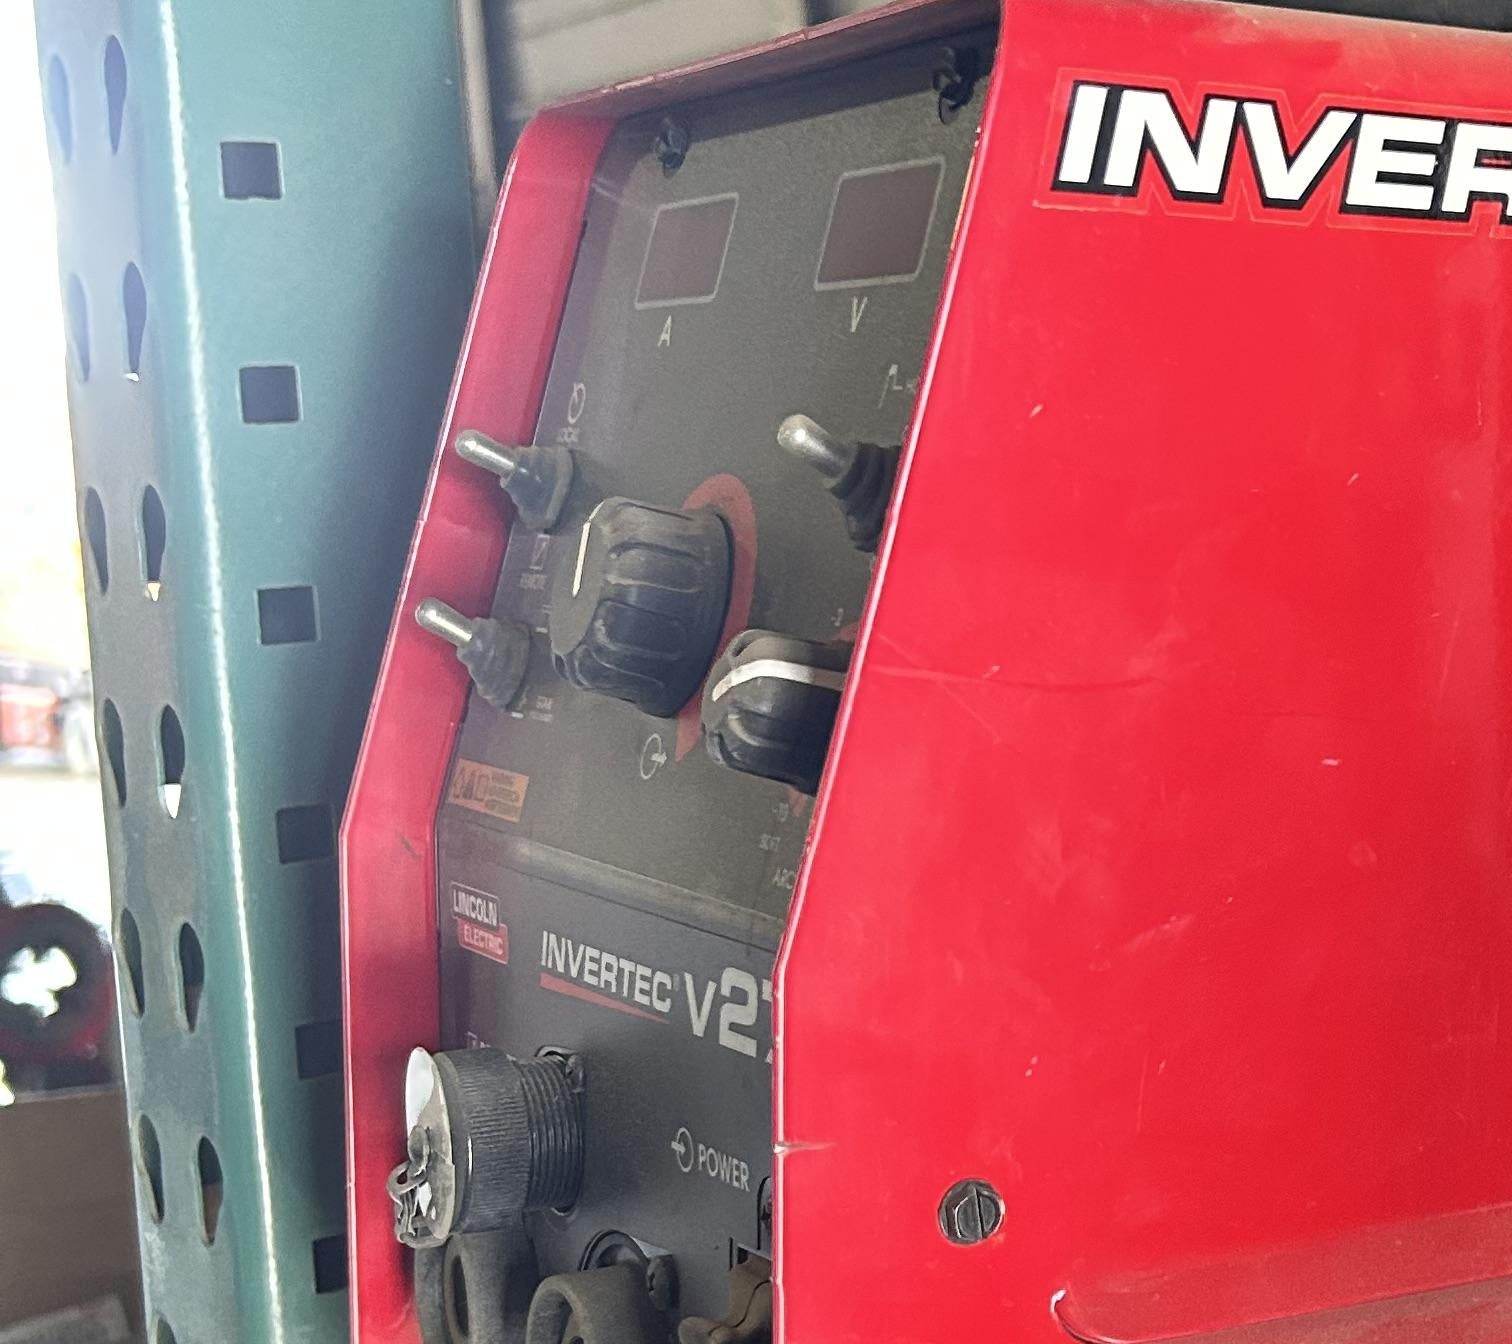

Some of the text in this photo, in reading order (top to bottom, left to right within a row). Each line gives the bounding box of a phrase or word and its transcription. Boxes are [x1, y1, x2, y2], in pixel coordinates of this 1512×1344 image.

[849, 296, 869, 333] V
[452, 888, 498, 927] LINCOLN
[463, 924, 504, 956] ELECTRIC
[540, 929, 672, 1014] INVERTEC
[696, 1142, 750, 1193] POWER
